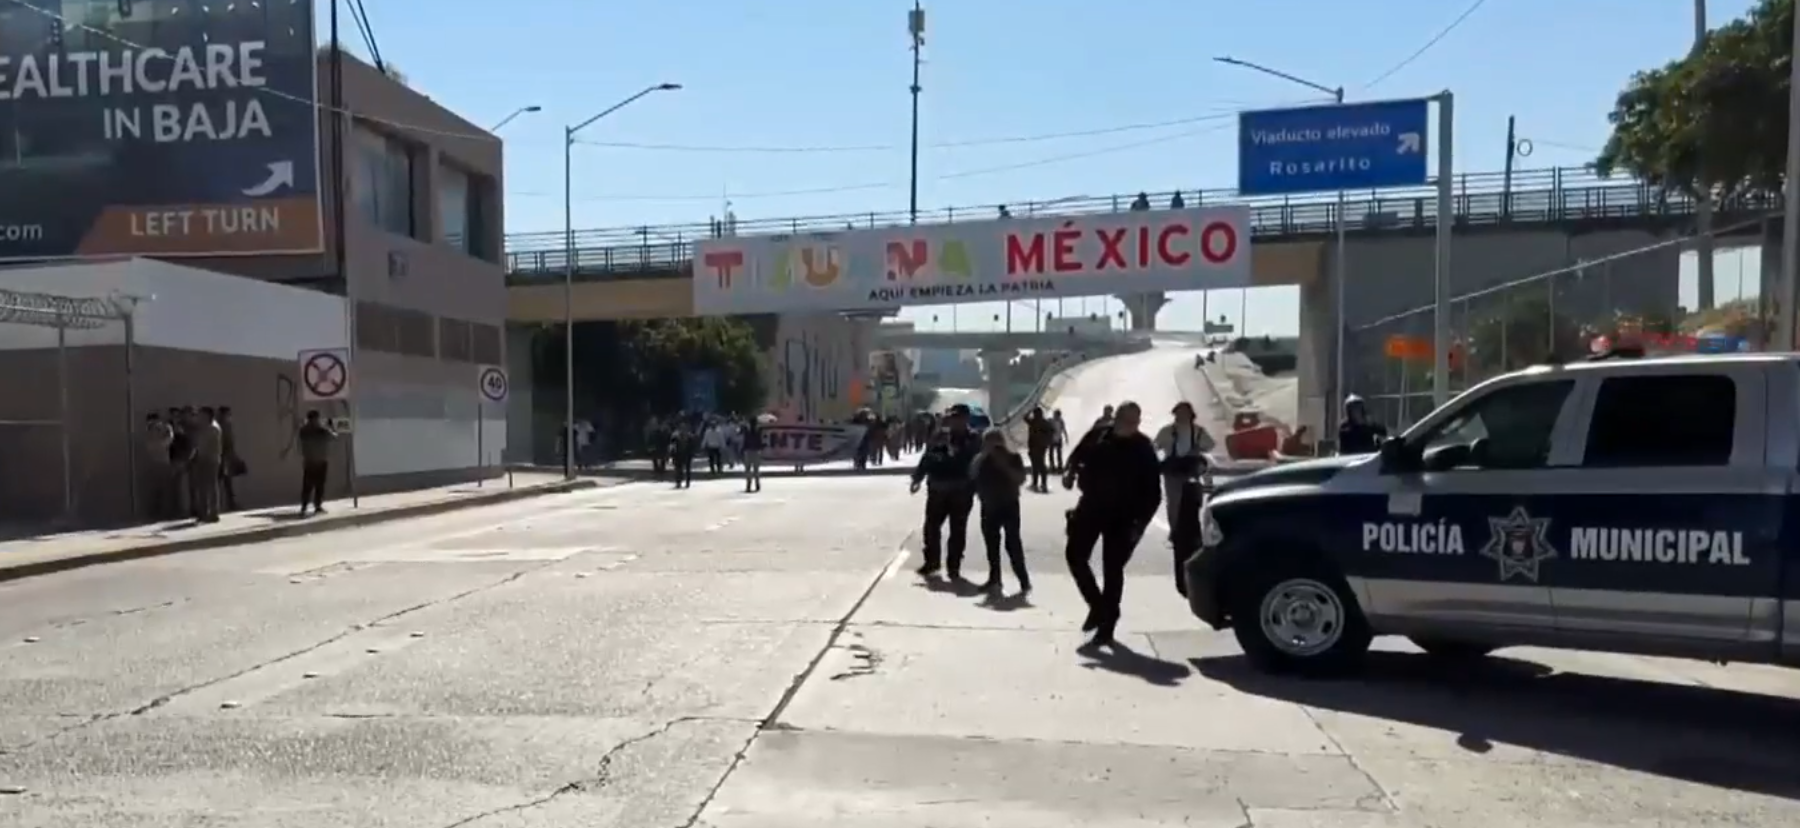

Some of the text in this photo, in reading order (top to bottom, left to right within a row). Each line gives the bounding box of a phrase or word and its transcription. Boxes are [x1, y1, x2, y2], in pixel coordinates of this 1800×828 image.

[103, 99, 272, 142] IN BAJA
[1251, 122, 1391, 146] Viaducto elevado
[1269, 157, 1371, 175] Rosarito
[131, 206, 280, 237] LEFT TURN
[1006, 221, 1238, 275] MÉXICO
[909, 283, 974, 299] EMPIEZA
[1001, 279, 1056, 294] PATRIA
[487, 375, 503, 391] 40
[1362, 517, 1752, 566] POLICÍA MUNICIPAL
